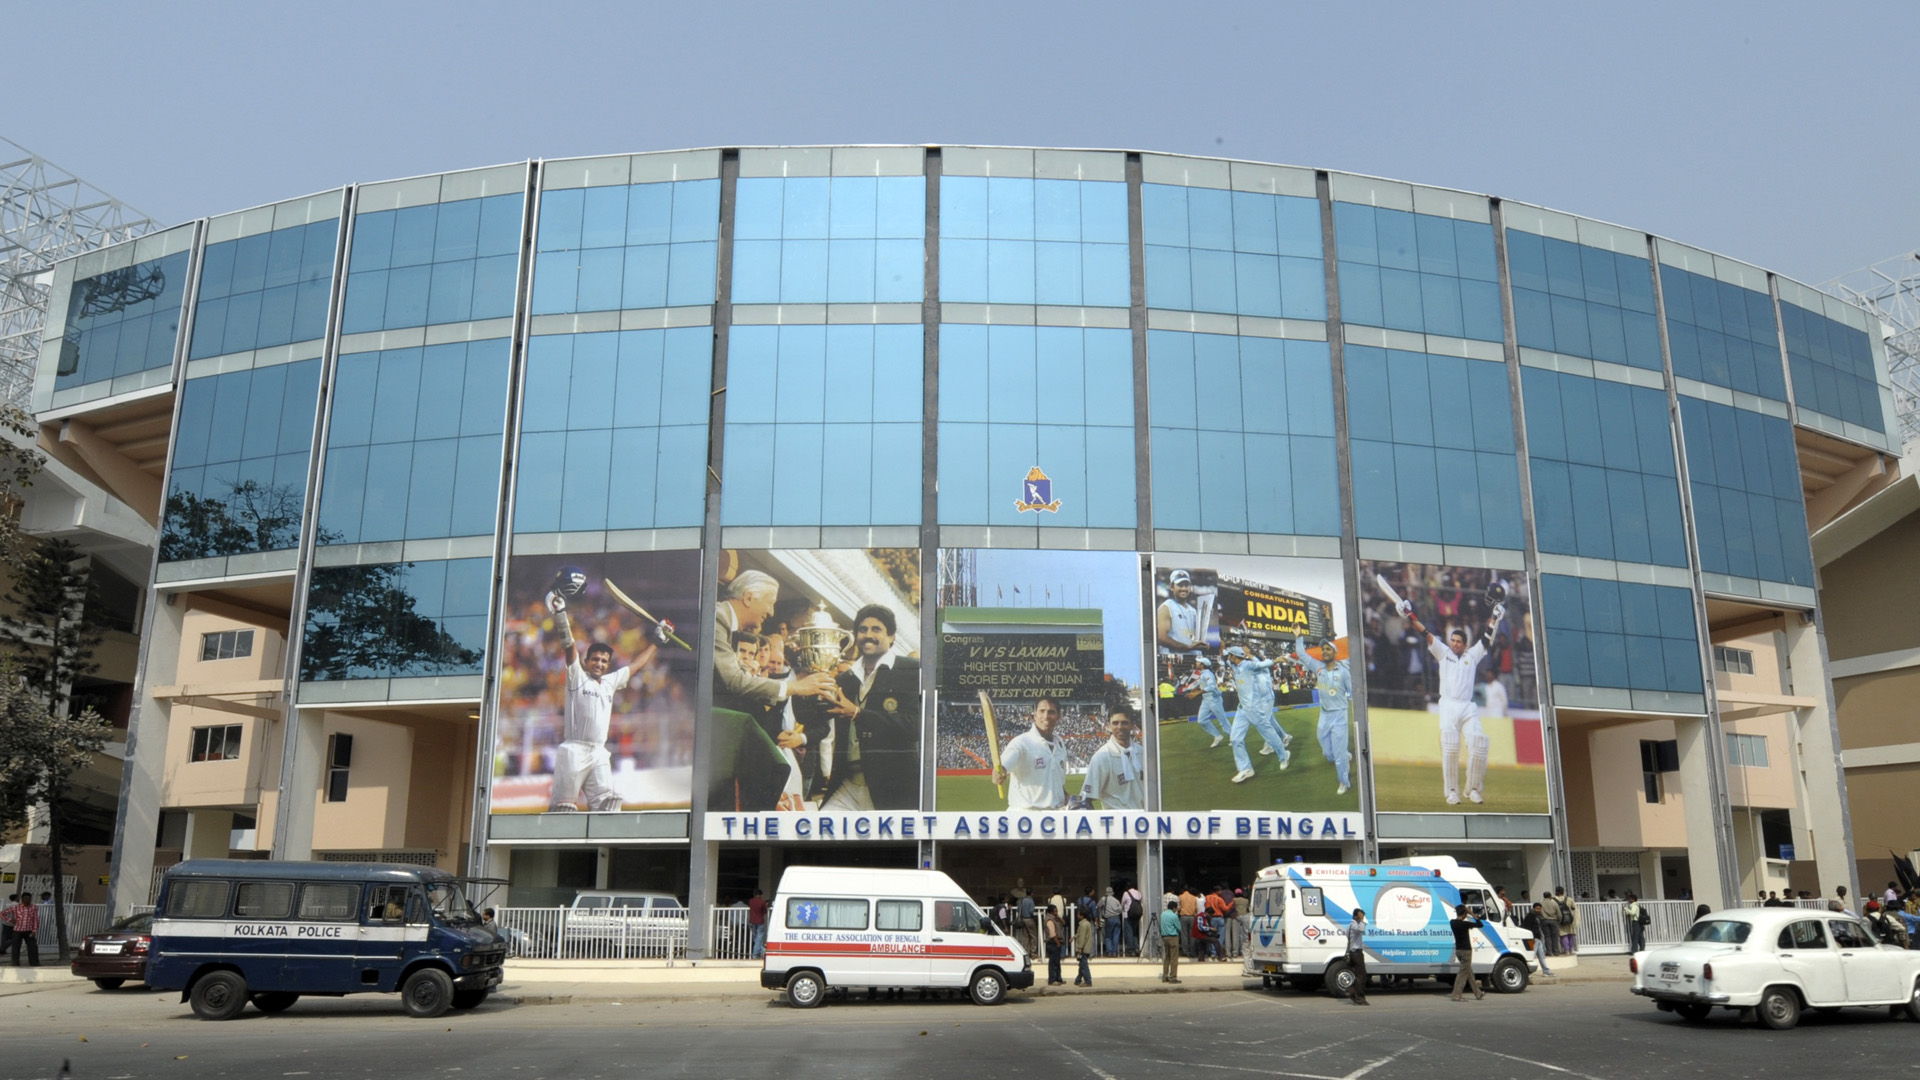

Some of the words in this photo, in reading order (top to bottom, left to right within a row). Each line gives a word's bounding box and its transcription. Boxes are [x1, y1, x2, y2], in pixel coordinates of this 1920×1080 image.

[1243, 589, 1305, 608] CONGRATULATION
[1246, 600, 1308, 625] INDIA
[1246, 620, 1263, 630] T20
[1264, 623, 1310, 636] CHAMPNS
[943, 634, 985, 646] Congrats
[969, 646, 981, 658] V
[983, 646, 994, 658] V
[995, 646, 1006, 658] S
[1008, 646, 1070, 658] LAXMAN
[964, 661, 1016, 672] HIGHEST
[1017, 661, 1080, 672] INDIVIDUAL
[959, 674, 999, 685] SCORE
[1001, 674, 1016, 685] BY
[1018, 674, 1040, 685] ANY
[1045, 674, 1083, 685] INDIAN
[992, 688, 1022, 698] TEST
[1023, 687, 1074, 698] CRICKET
[722, 816, 779, 836] THE
[795, 816, 937, 836] CRICKET
[954, 816, 1172, 835] ASSOCIATION
[1186, 816, 1222, 835] OF
[1236, 816, 1357, 836] BENGAL
[234, 925, 288, 936] KOLKATA
[298, 926, 342, 938] POLICE
[784, 932, 799, 941] THE
[801, 933, 833, 941] CRICKET
[835, 933, 884, 942] ASSOCIATION
[884, 934, 894, 942] OF
[895, 934, 921, 943] BENGAL
[1321, 928, 1335, 936] The
[1368, 929, 1395, 937] Medical
[1396, 929, 1429, 937] Research
[1429, 929, 1453, 937] Institu
[871, 944, 926, 954] AMBULANCE
